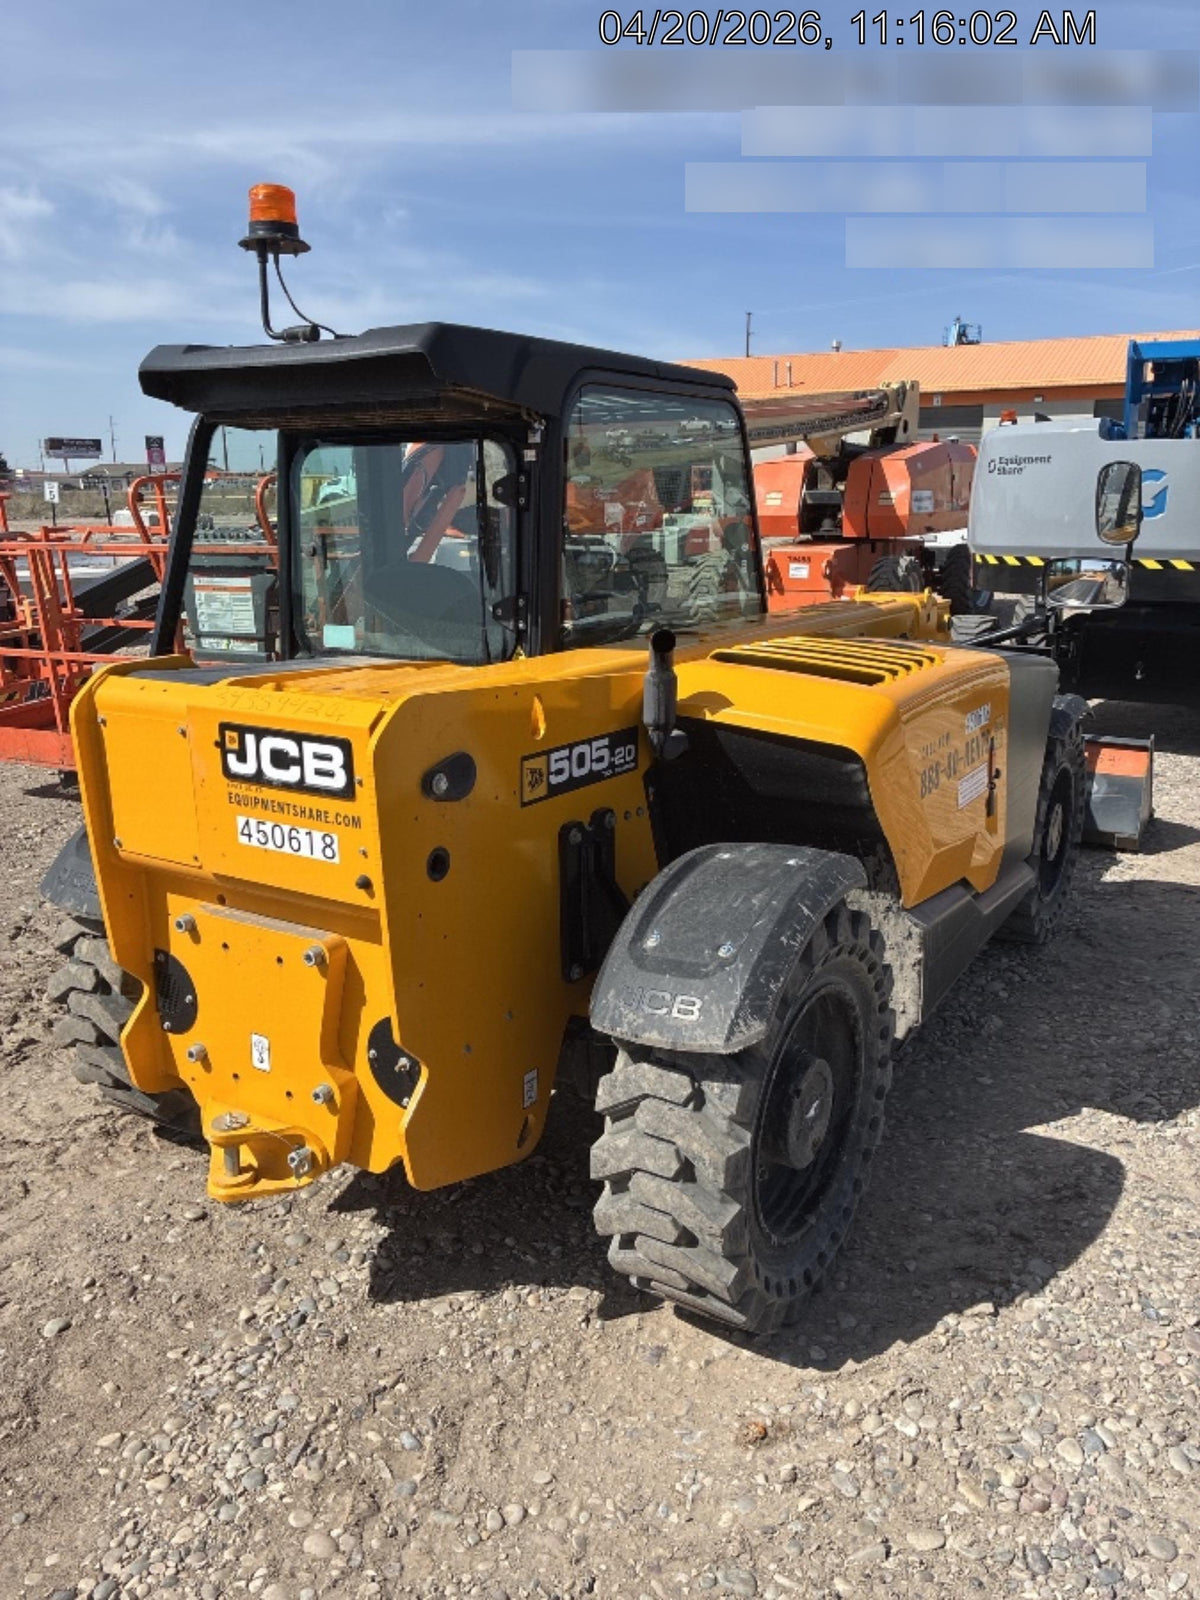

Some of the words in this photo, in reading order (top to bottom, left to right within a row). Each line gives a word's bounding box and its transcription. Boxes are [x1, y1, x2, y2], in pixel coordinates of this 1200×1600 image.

[997, 466, 1023, 475] Share
[999, 455, 1052, 466] Equipment
[226, 733, 347, 790] JCB
[228, 792, 362, 829] EQUIPMENTSHARE.COM
[240, 818, 337, 860] 450618
